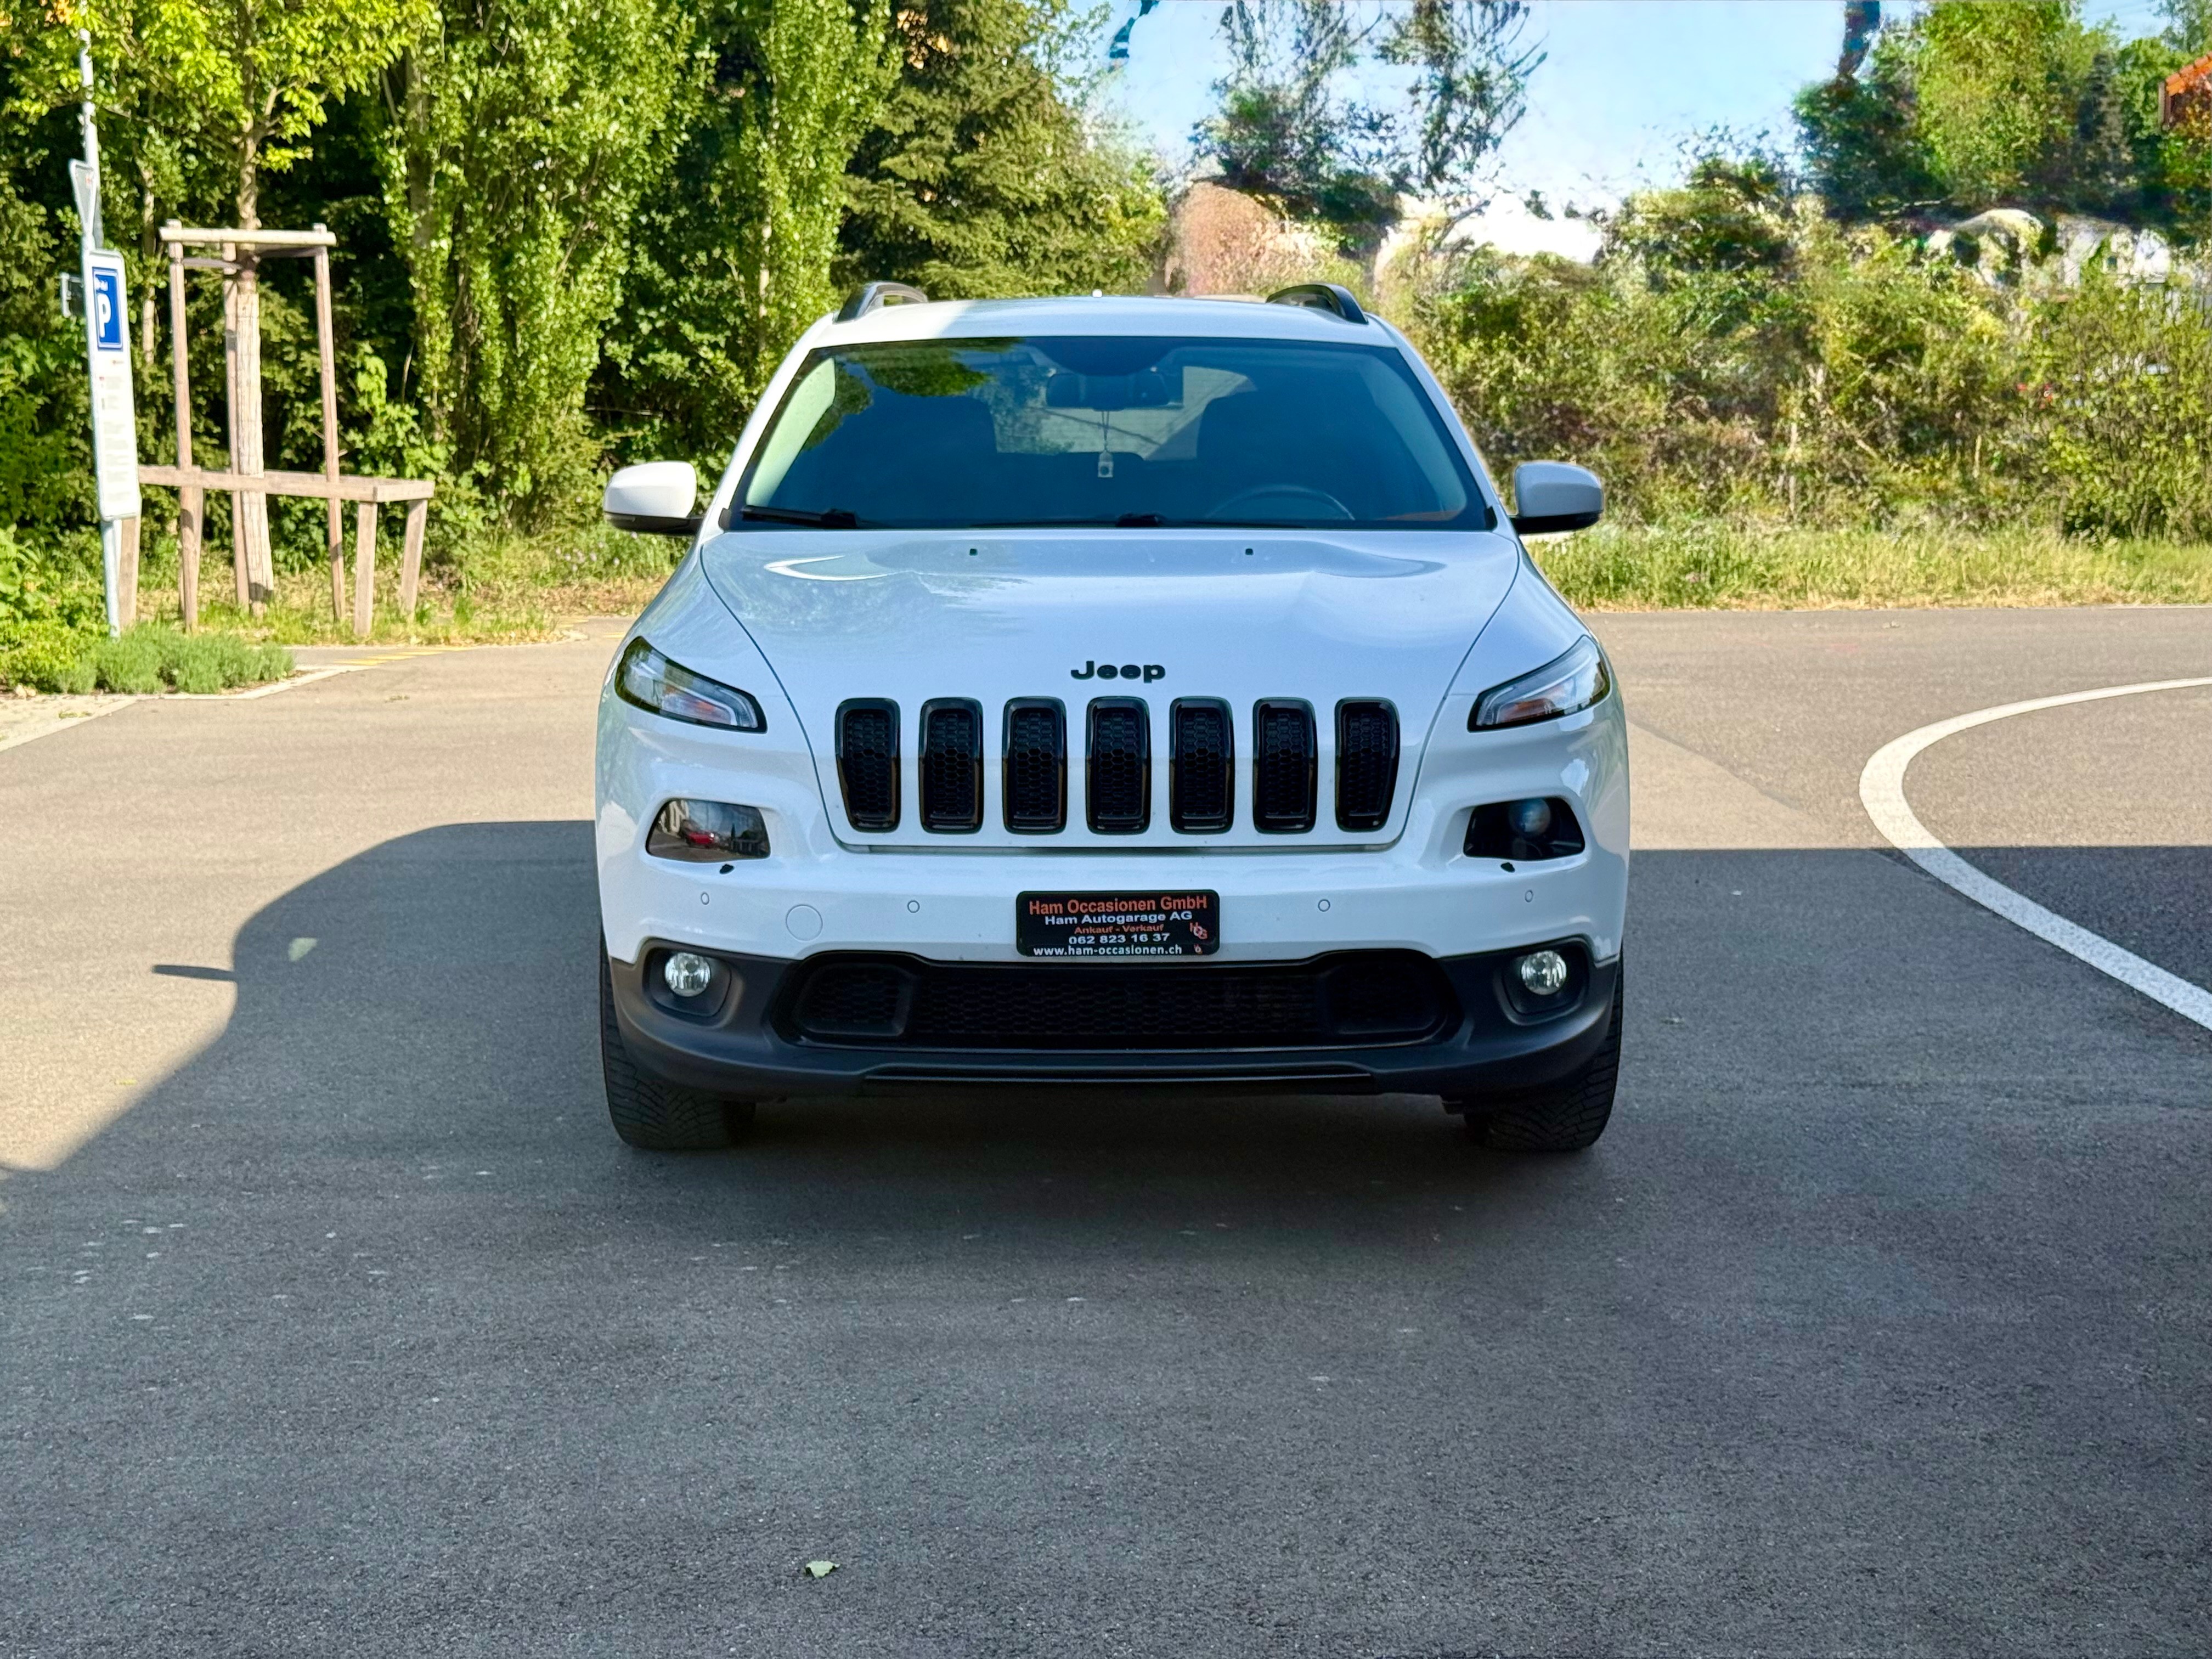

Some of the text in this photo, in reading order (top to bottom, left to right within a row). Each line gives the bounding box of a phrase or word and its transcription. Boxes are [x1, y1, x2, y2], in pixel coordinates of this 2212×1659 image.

[97, 292, 111, 338] P
[1070, 660, 1166, 684] Jeep
[1029, 895, 1208, 915] Ham Occasionen GmbH
[1045, 910, 1193, 926] Ham Autogarage AG
[1074, 926, 1113, 935] Ankauf
[1121, 924, 1165, 933] Verkauf
[1069, 933, 1171, 945] 062 823 16 37
[1033, 944, 1182, 957] www.ham-occasionen.ch
